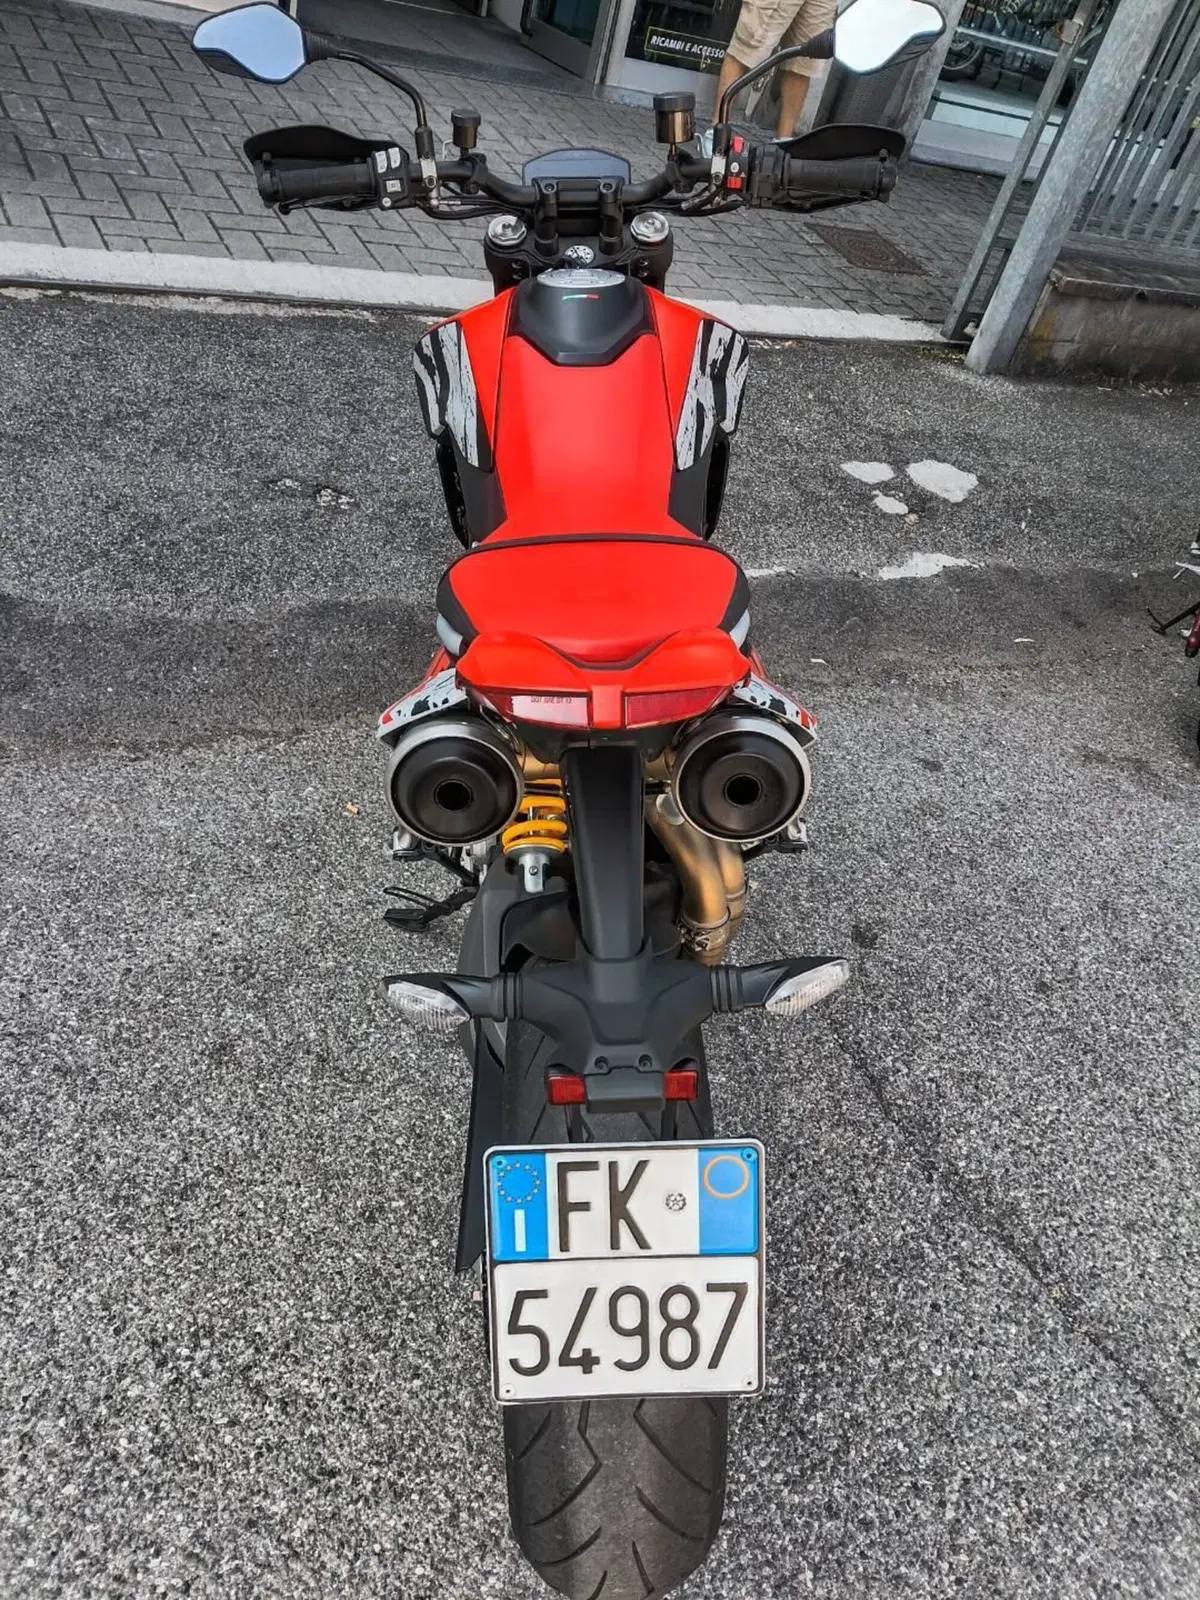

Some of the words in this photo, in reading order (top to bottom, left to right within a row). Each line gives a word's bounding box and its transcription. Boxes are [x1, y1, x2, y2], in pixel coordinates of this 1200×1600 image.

[650, 35, 684, 50] RICAMBI
[685, 43, 691, 52] E
[514, 1209, 526, 1252] I
[557, 1160, 652, 1252] FK
[507, 1282, 748, 1377] 54987
